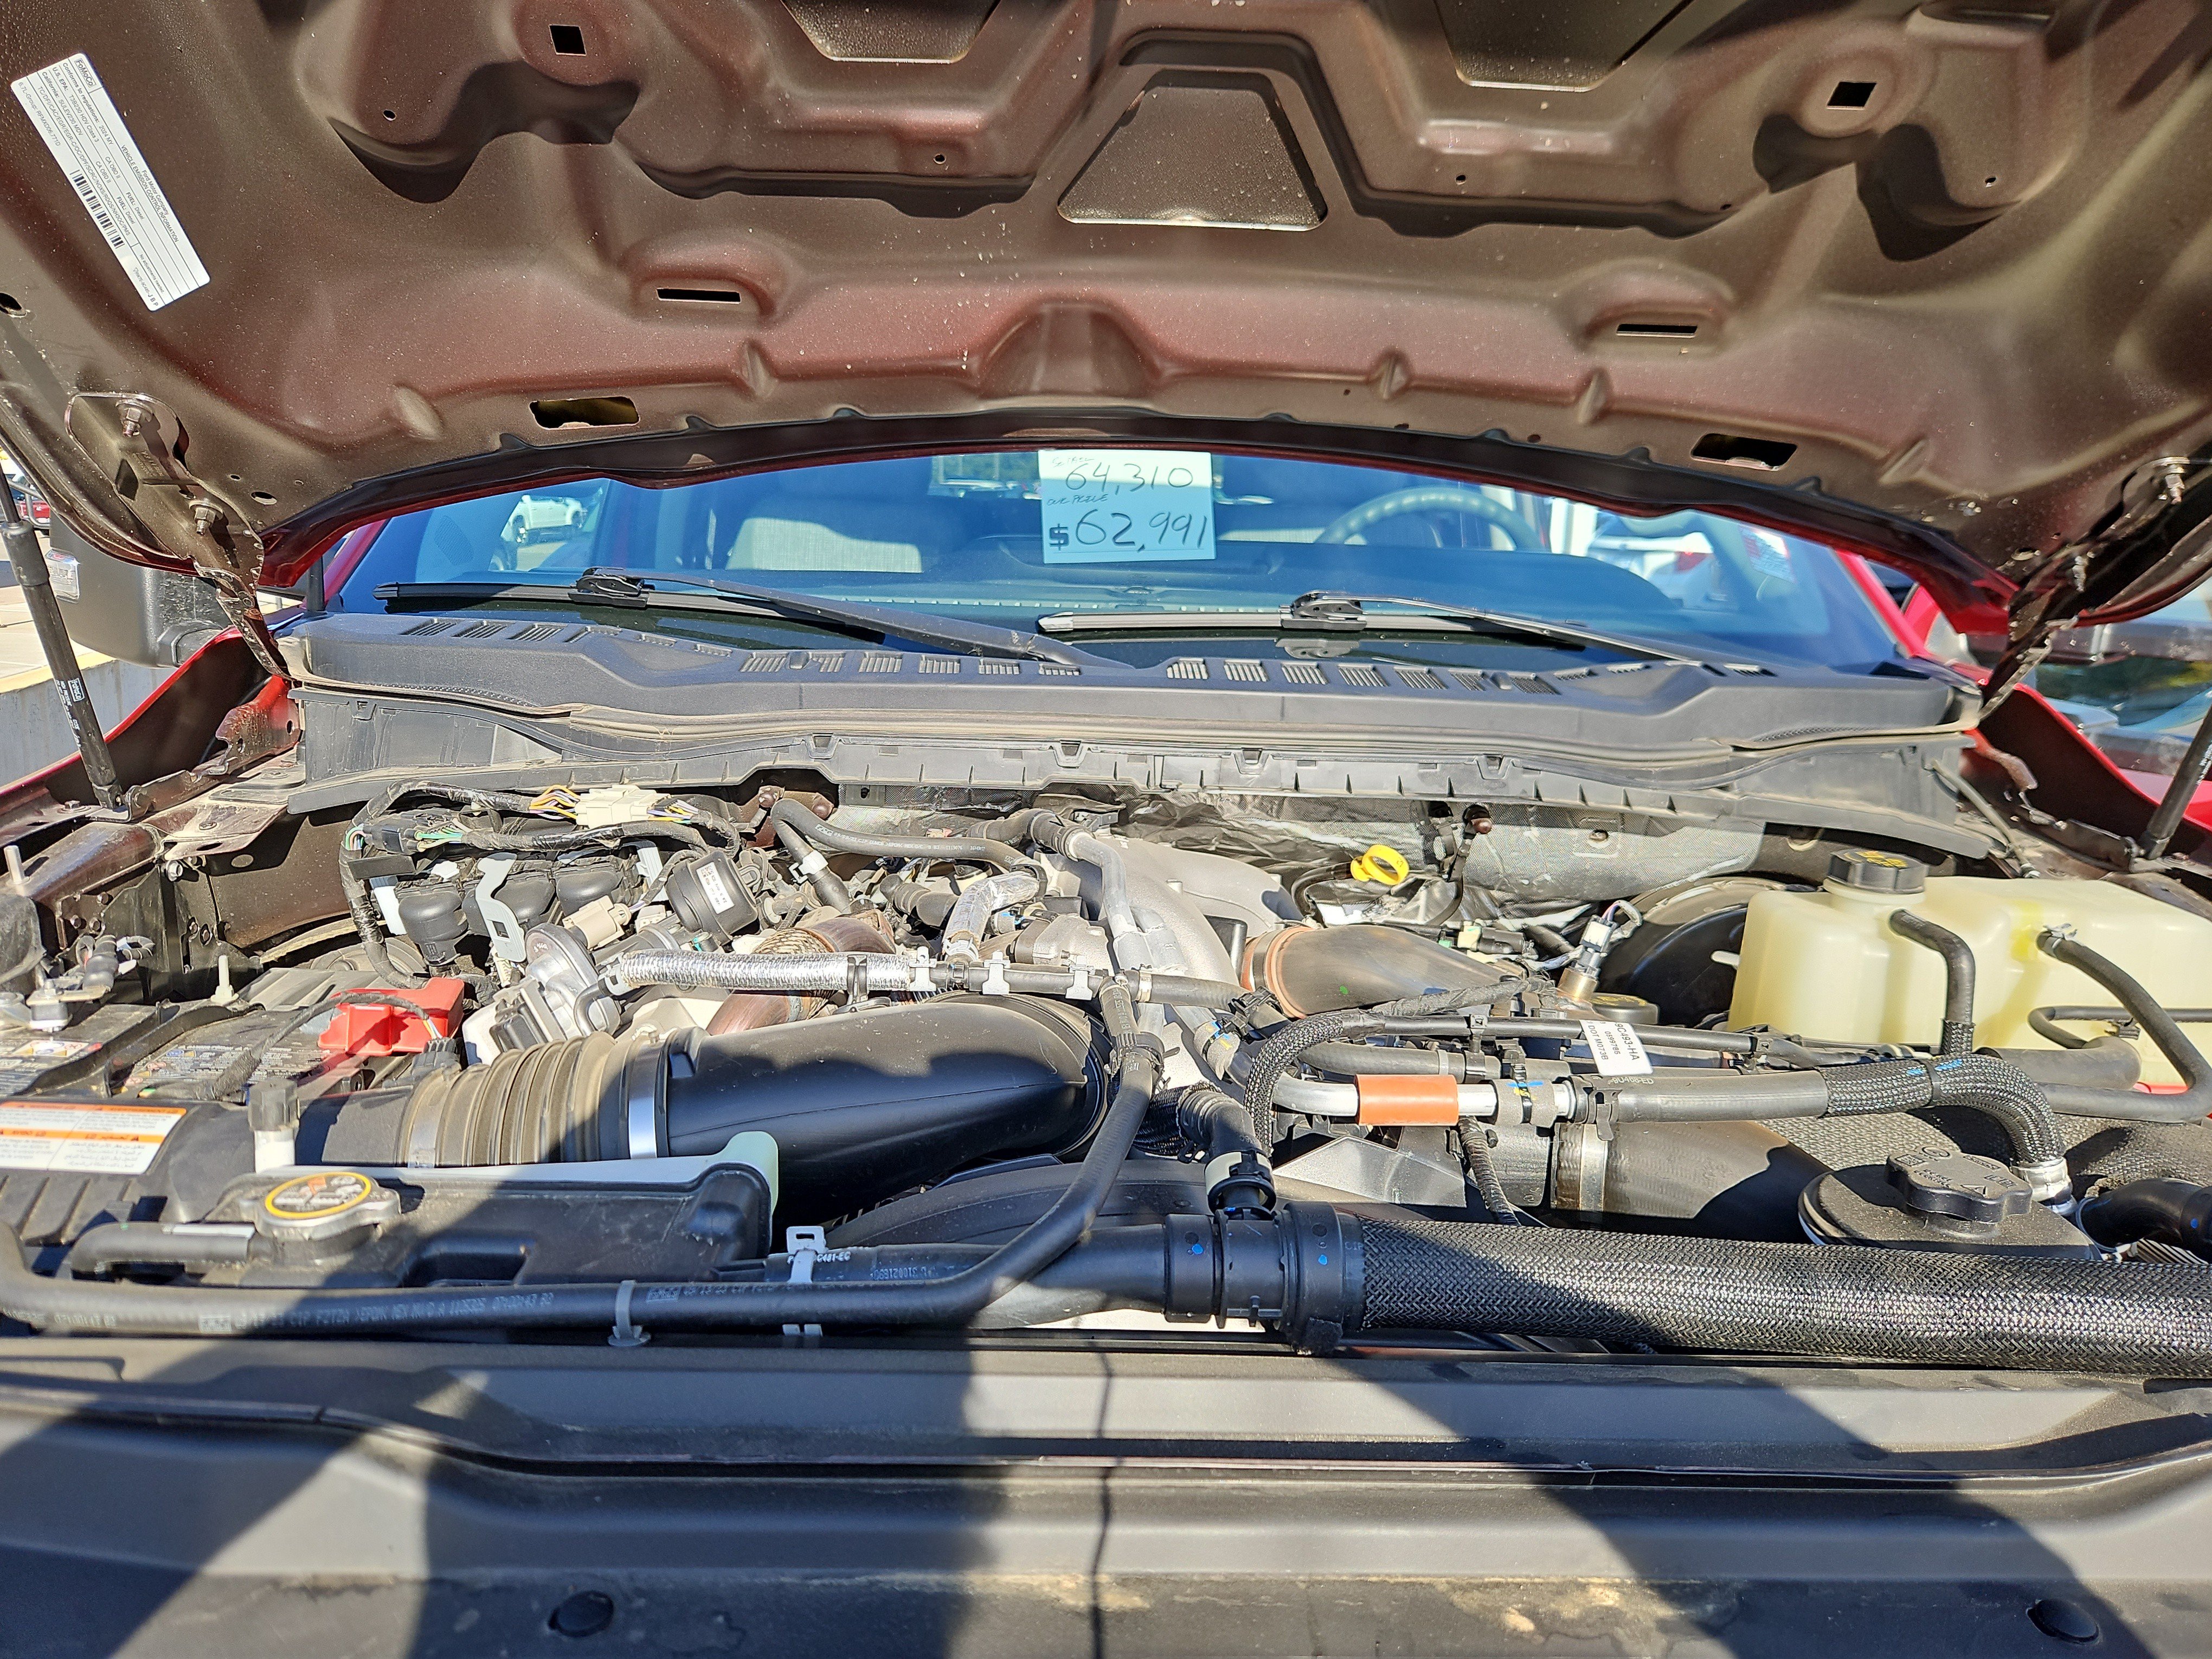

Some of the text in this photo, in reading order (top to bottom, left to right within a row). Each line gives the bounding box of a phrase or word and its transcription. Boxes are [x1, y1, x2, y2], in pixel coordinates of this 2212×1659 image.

[75, 59, 95, 87] FoMoCo
[62, 62, 79, 88] Conforms
[80, 94, 100, 124] regulations:
[99, 125, 108, 137] 2024
[106, 137, 113, 145] MY
[41, 70, 60, 98] California:
[58, 99, 75, 124] SULEV230
[73, 124, 82, 136] MDV
[95, 160, 102, 169] CA
[99, 168, 108, 180] OBD
[116, 196, 127, 210] FUEL:
[125, 211, 135, 224] Diesel
[52, 67, 61, 79] U.S.
[59, 78, 69, 91] EPA:
[79, 113, 89, 125] HDV
[86, 125, 97, 138] Class
[105, 156, 112, 164] CA
[109, 163, 118, 175] OBD
[125, 191, 137, 206] FUEL:
[134, 206, 145, 220] Diesel
[120, 145, 179, 242] VEHICLE EMISSION CONTROL INFORMATION
[141, 170, 170, 216] Ford Motor Company
[142, 259, 157, 280] adjustments
[1066, 462, 1193, 494] 64,310
[1049, 509, 1207, 552] $62,991
[71, 681, 82, 700] FoMoCo
[1588, 1025, 1599, 1037] DOT
